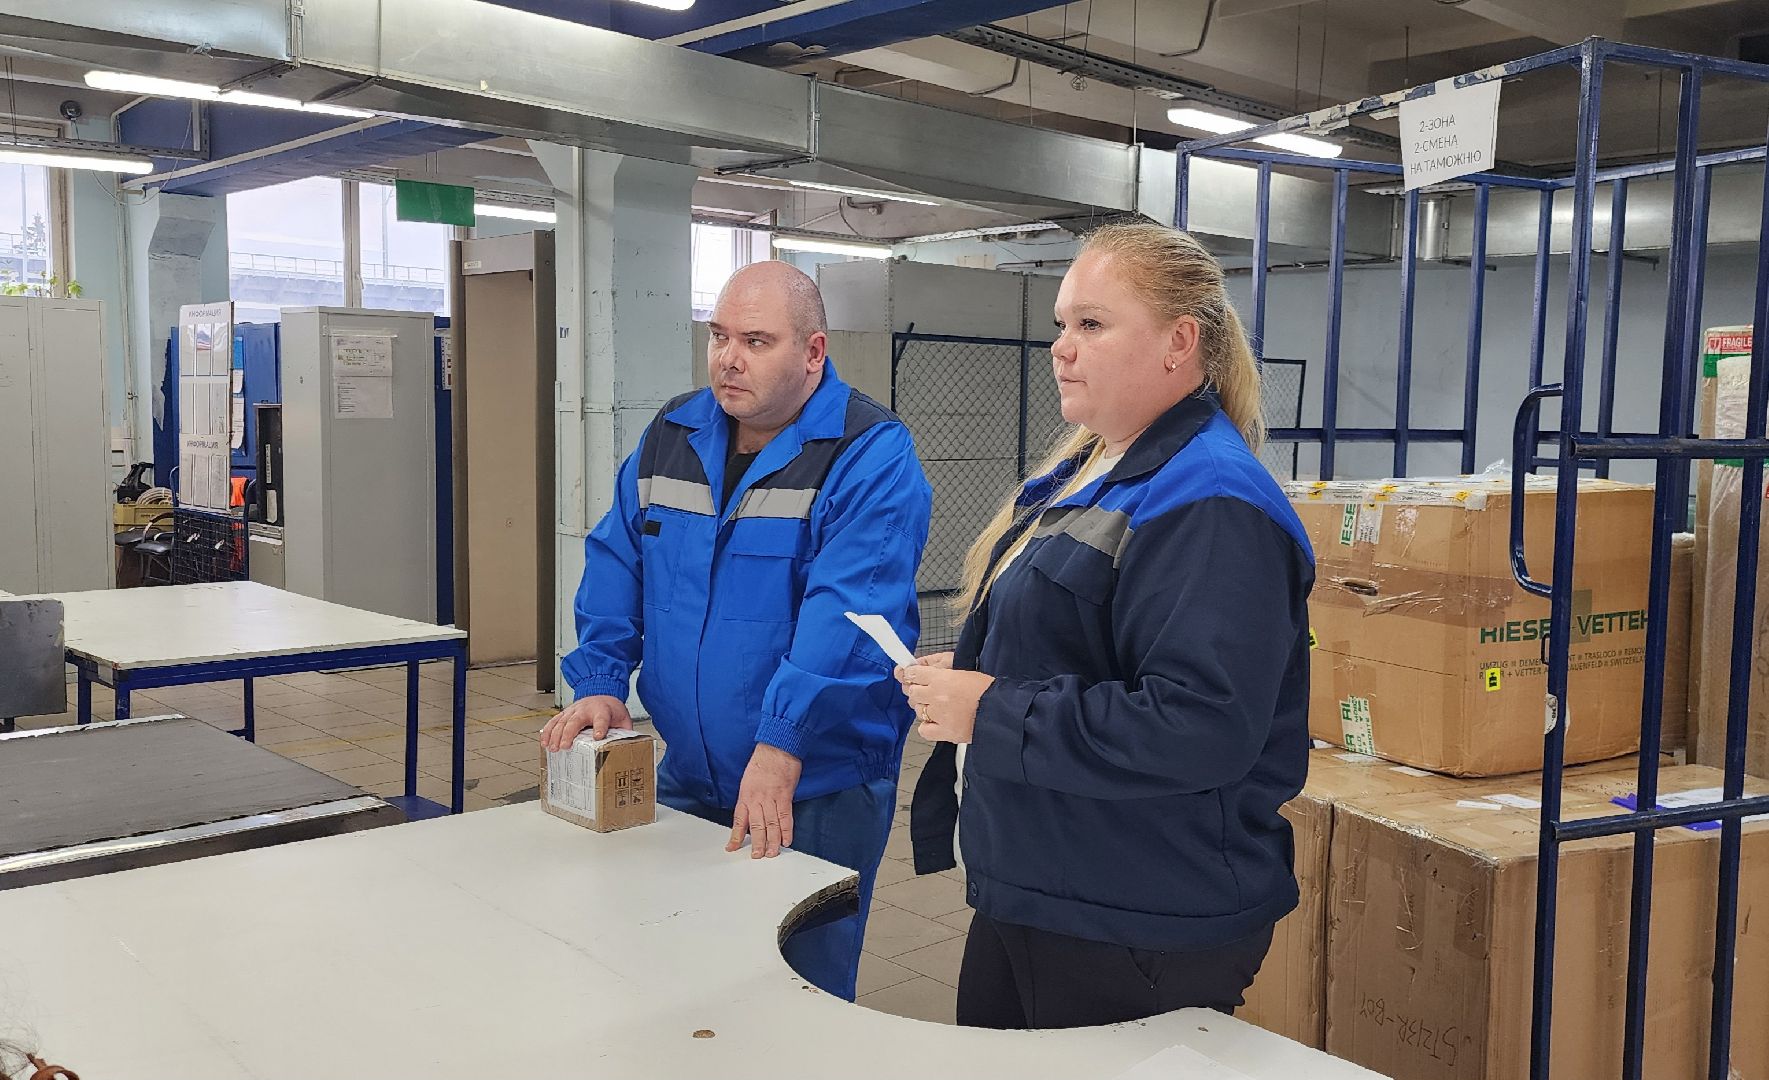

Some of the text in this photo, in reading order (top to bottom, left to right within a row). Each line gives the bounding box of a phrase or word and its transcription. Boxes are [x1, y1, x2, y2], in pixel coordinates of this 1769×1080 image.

[1419, 114, 1456, 133] 2-ЗОНА
[1414, 135, 1459, 154] 2-СМЕНА
[1410, 150, 1482, 175] НА ТАМОЖНЮ
